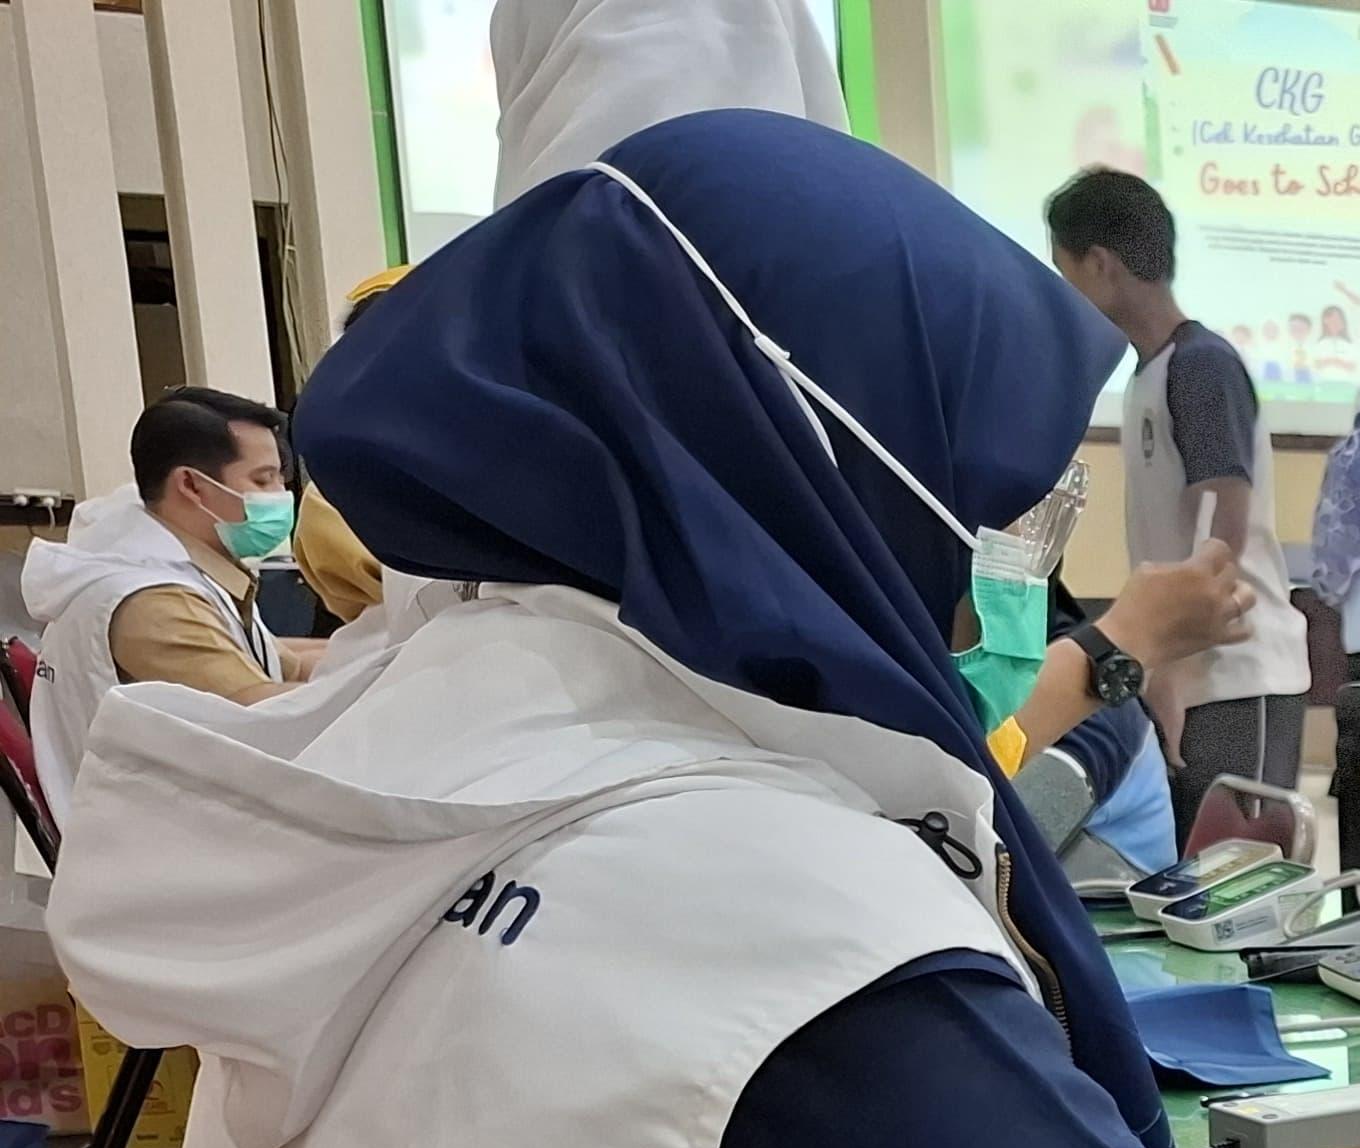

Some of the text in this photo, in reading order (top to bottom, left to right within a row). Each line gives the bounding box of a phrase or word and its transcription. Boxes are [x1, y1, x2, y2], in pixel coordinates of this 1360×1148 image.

[1255, 67, 1325, 116] CKG
[1244, 121, 1339, 146] Kesehatan
[1200, 161, 1260, 196] Goes
[1271, 163, 1305, 196] to
